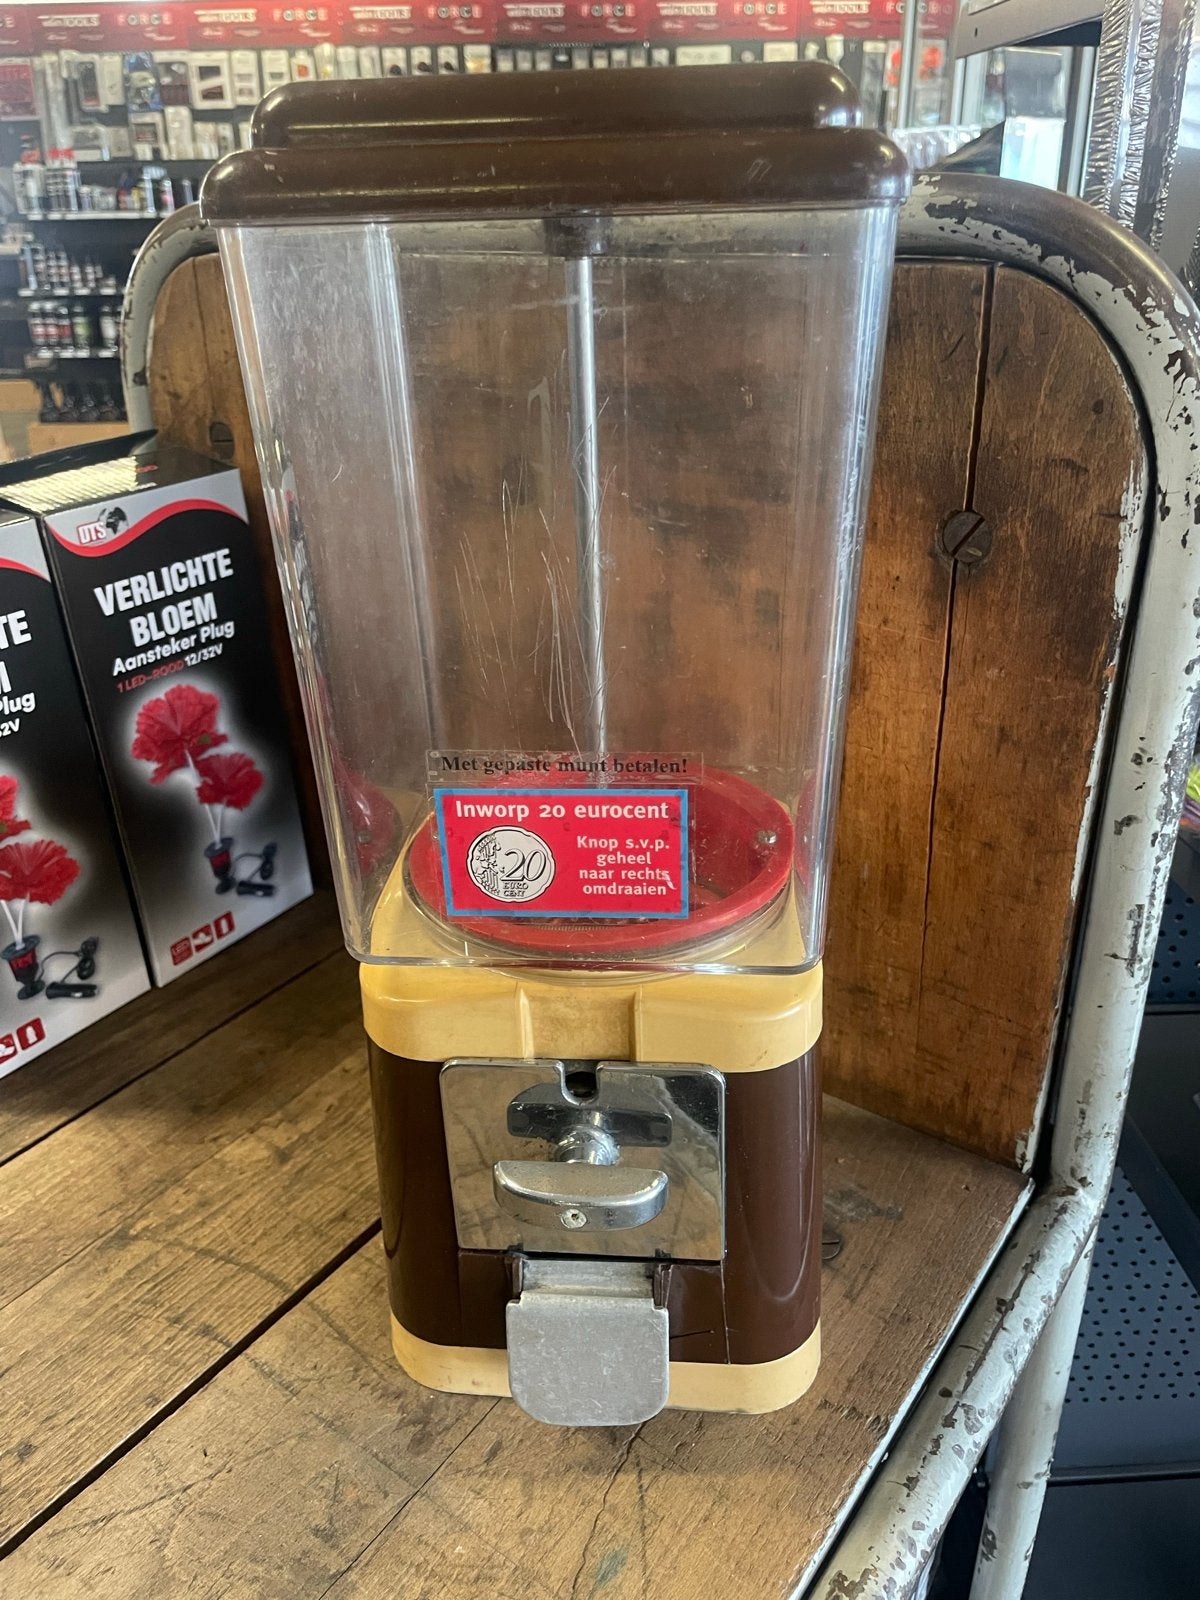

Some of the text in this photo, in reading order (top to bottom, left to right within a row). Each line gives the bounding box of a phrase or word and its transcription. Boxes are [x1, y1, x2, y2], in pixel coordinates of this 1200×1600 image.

[93, 548, 235, 617] VERLICHTE
[129, 592, 218, 647] BLOEM
[112, 621, 235, 676] Aansteker Plug
[0, 692, 36, 715] lug
[0, 718, 20, 738] 2V
[441, 756, 687, 775] Met gepaste munt betalen!
[455, 800, 669, 822] Inworp 20 eurocent
[576, 835, 670, 852] Knop s.v.p.
[500, 848, 547, 881] 20
[596, 851, 652, 867] geheel
[579, 867, 670, 880] naar rechts
[502, 882, 529, 890] EURO
[582, 882, 667, 896] omdraaien
